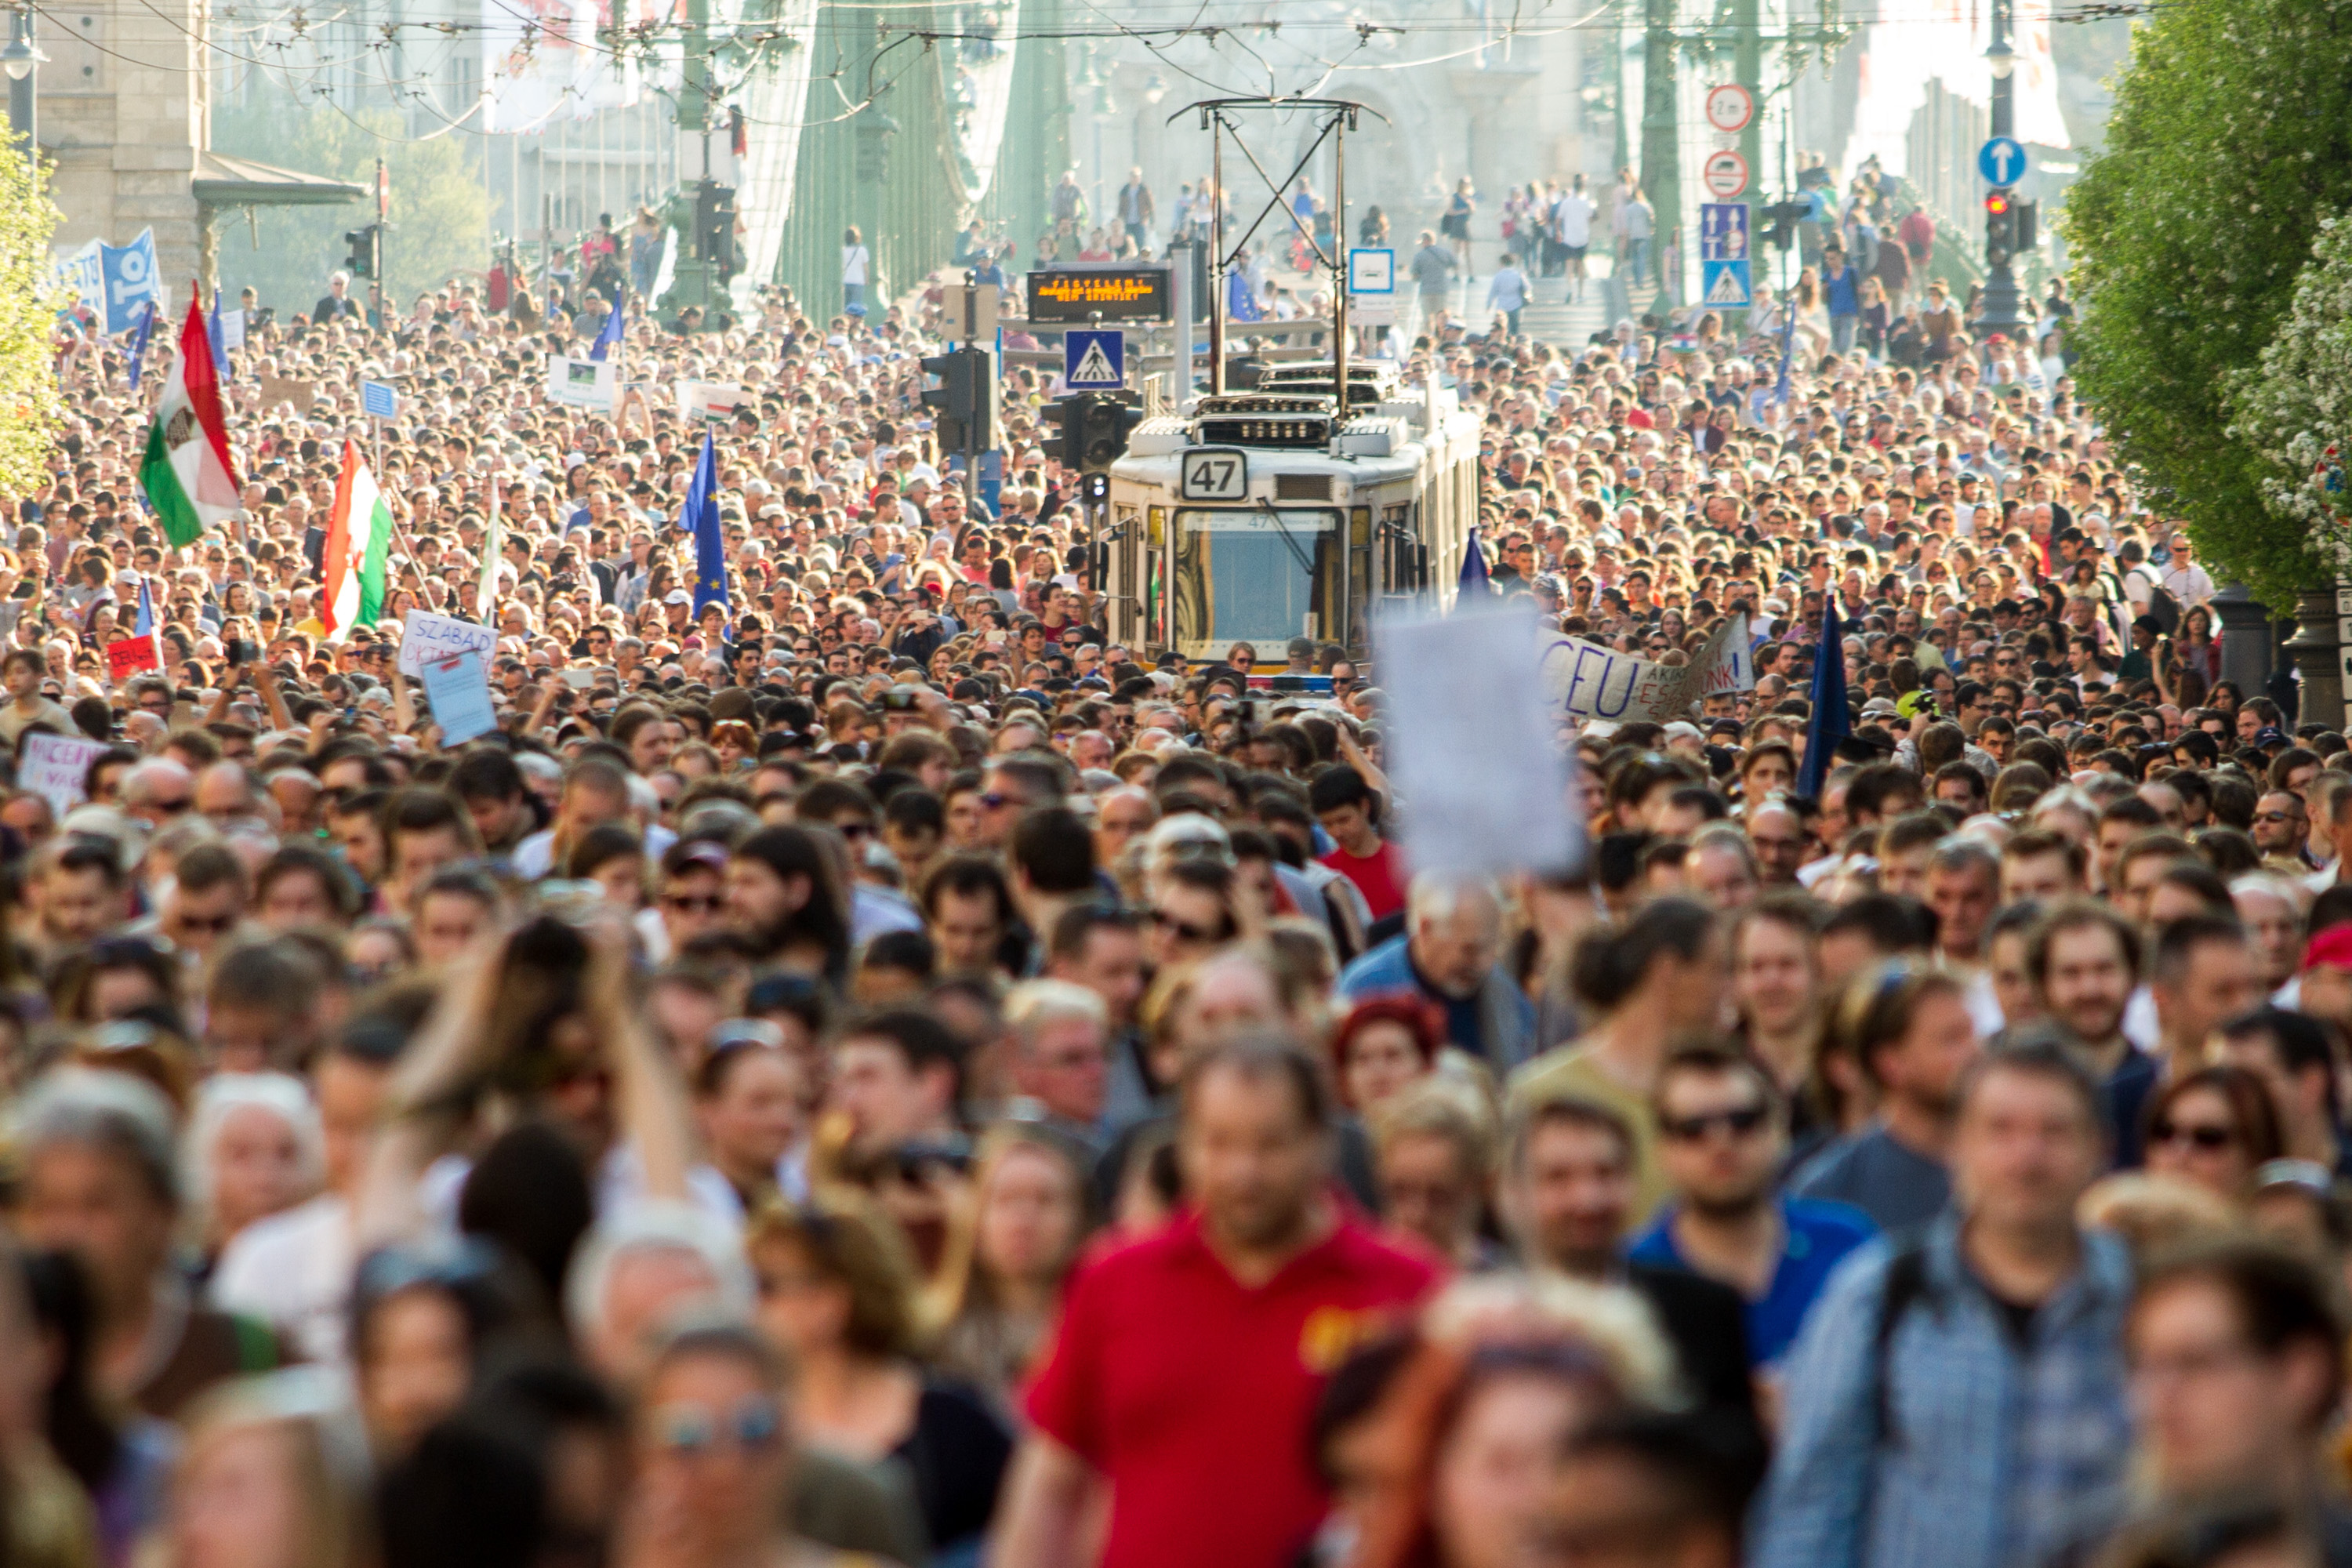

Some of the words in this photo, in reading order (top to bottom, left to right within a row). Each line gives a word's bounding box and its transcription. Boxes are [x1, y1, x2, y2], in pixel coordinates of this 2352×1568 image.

[1717, 100, 1723, 115] 2
[1728, 104, 1739, 114] m
[1190, 461, 1236, 492] 47
[1248, 517, 1269, 528] 47
[416, 619, 491, 652] SZABAD
[1539, 640, 1639, 717] CEU
